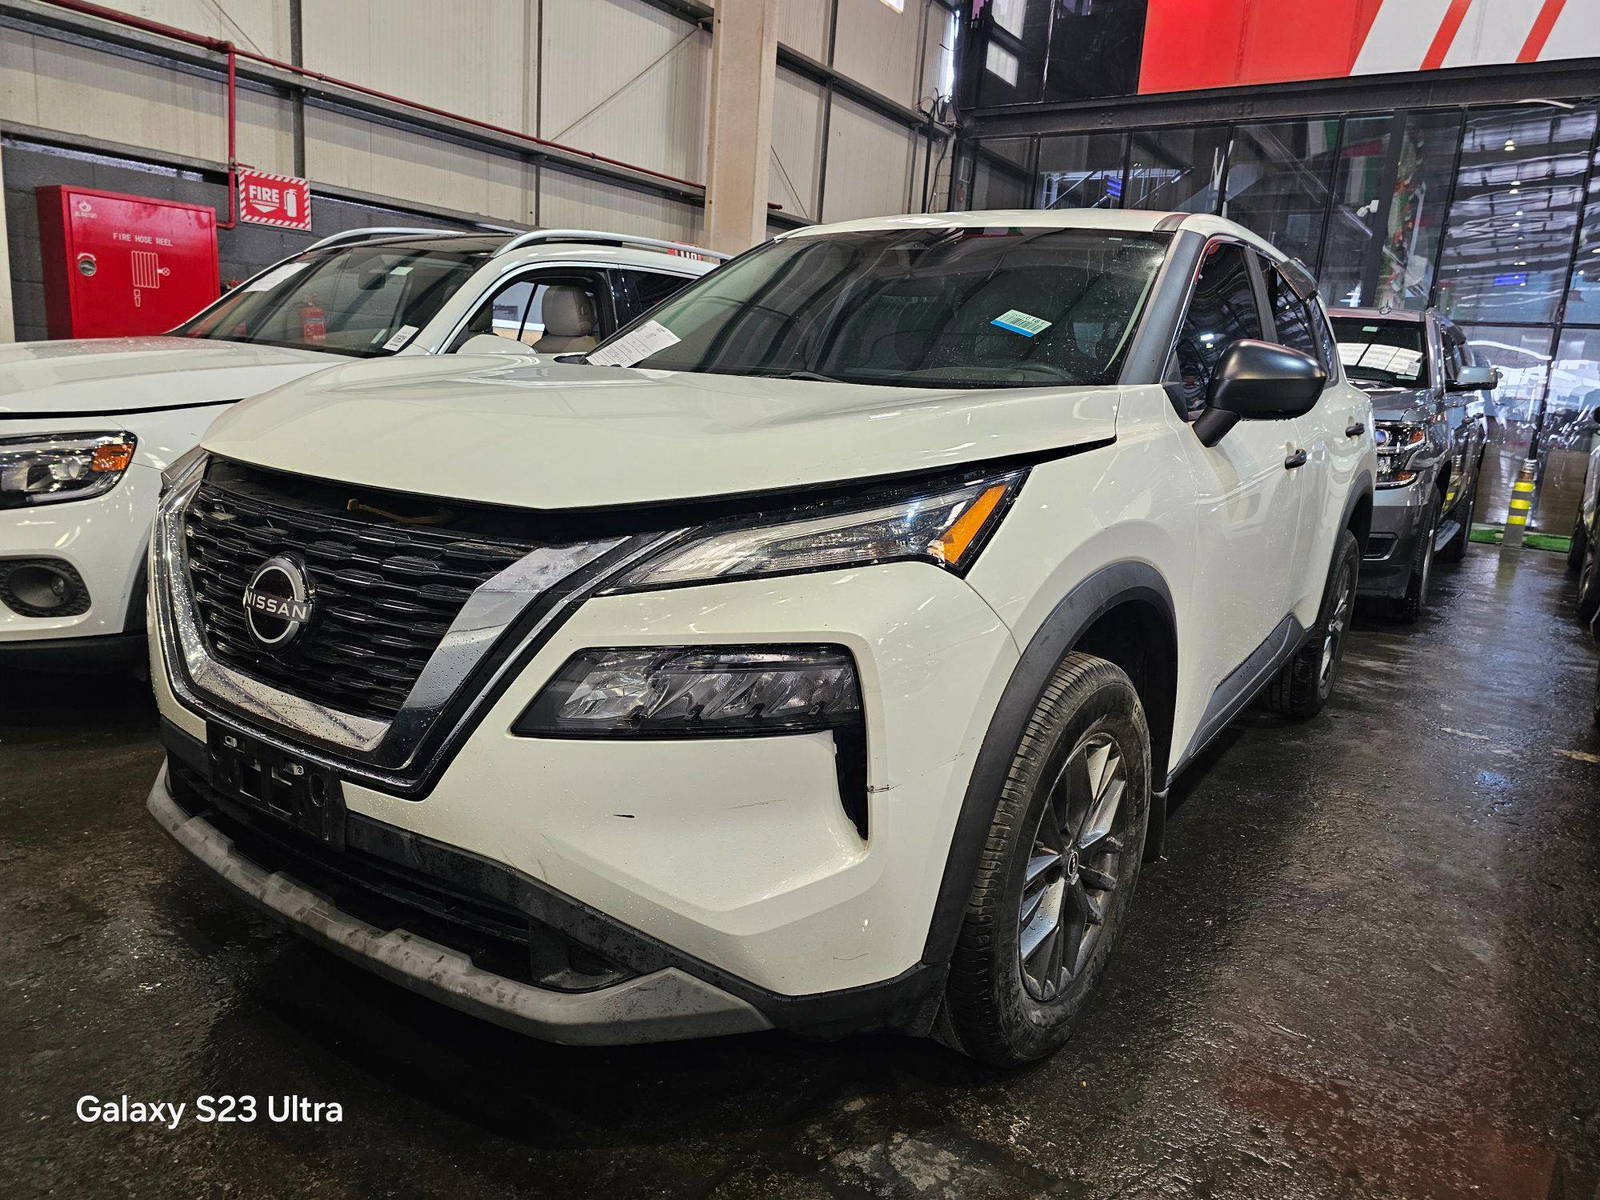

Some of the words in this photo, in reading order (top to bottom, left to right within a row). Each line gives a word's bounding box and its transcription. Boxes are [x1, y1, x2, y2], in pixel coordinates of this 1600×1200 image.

[249, 184, 280, 203] FIRE
[113, 232, 131, 242] FIRE
[134, 235, 153, 245] HOSE
[156, 237, 174, 247] REEL
[245, 591, 307, 619] NISSAN
